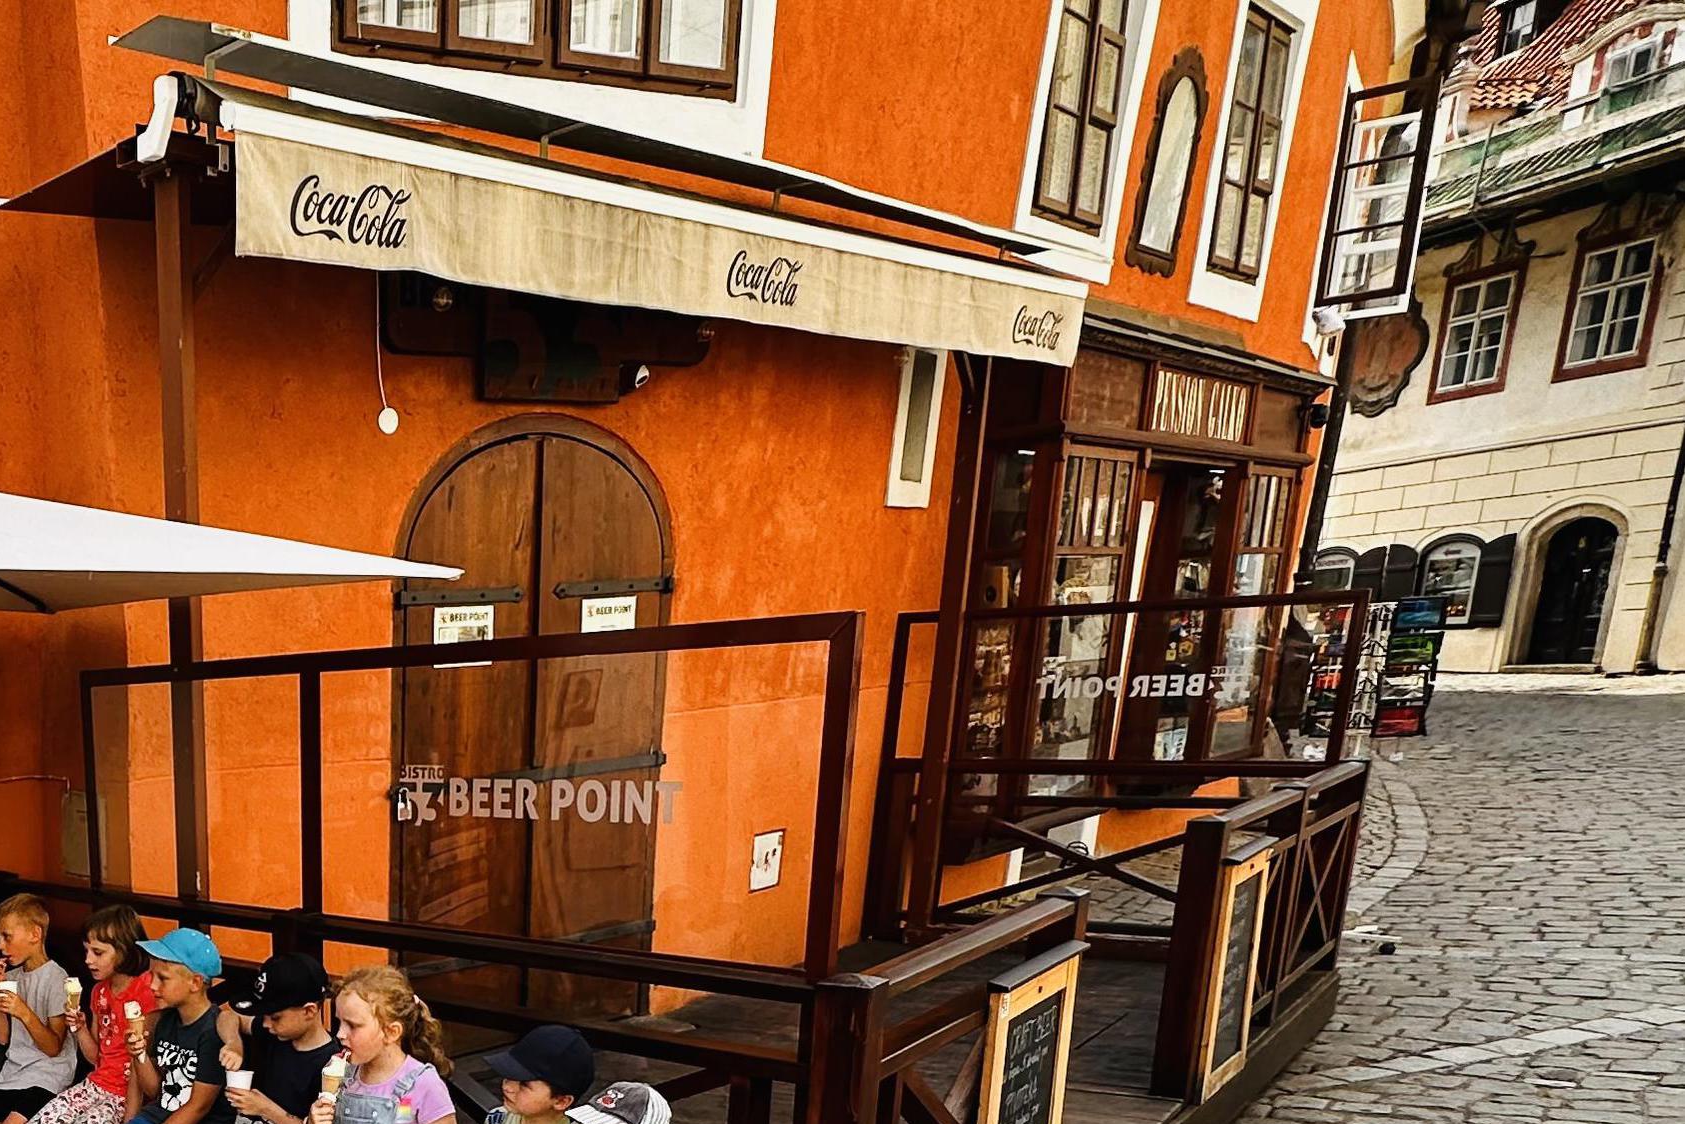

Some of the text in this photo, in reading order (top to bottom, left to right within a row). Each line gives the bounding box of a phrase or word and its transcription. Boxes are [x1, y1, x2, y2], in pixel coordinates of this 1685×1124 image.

[290, 174, 412, 249] Coca-Cola
[726, 250, 803, 306] Coca-Cola
[1151, 370, 1206, 437] PENSION
[448, 776, 541, 822] BEER
[550, 778, 684, 826] POINT
